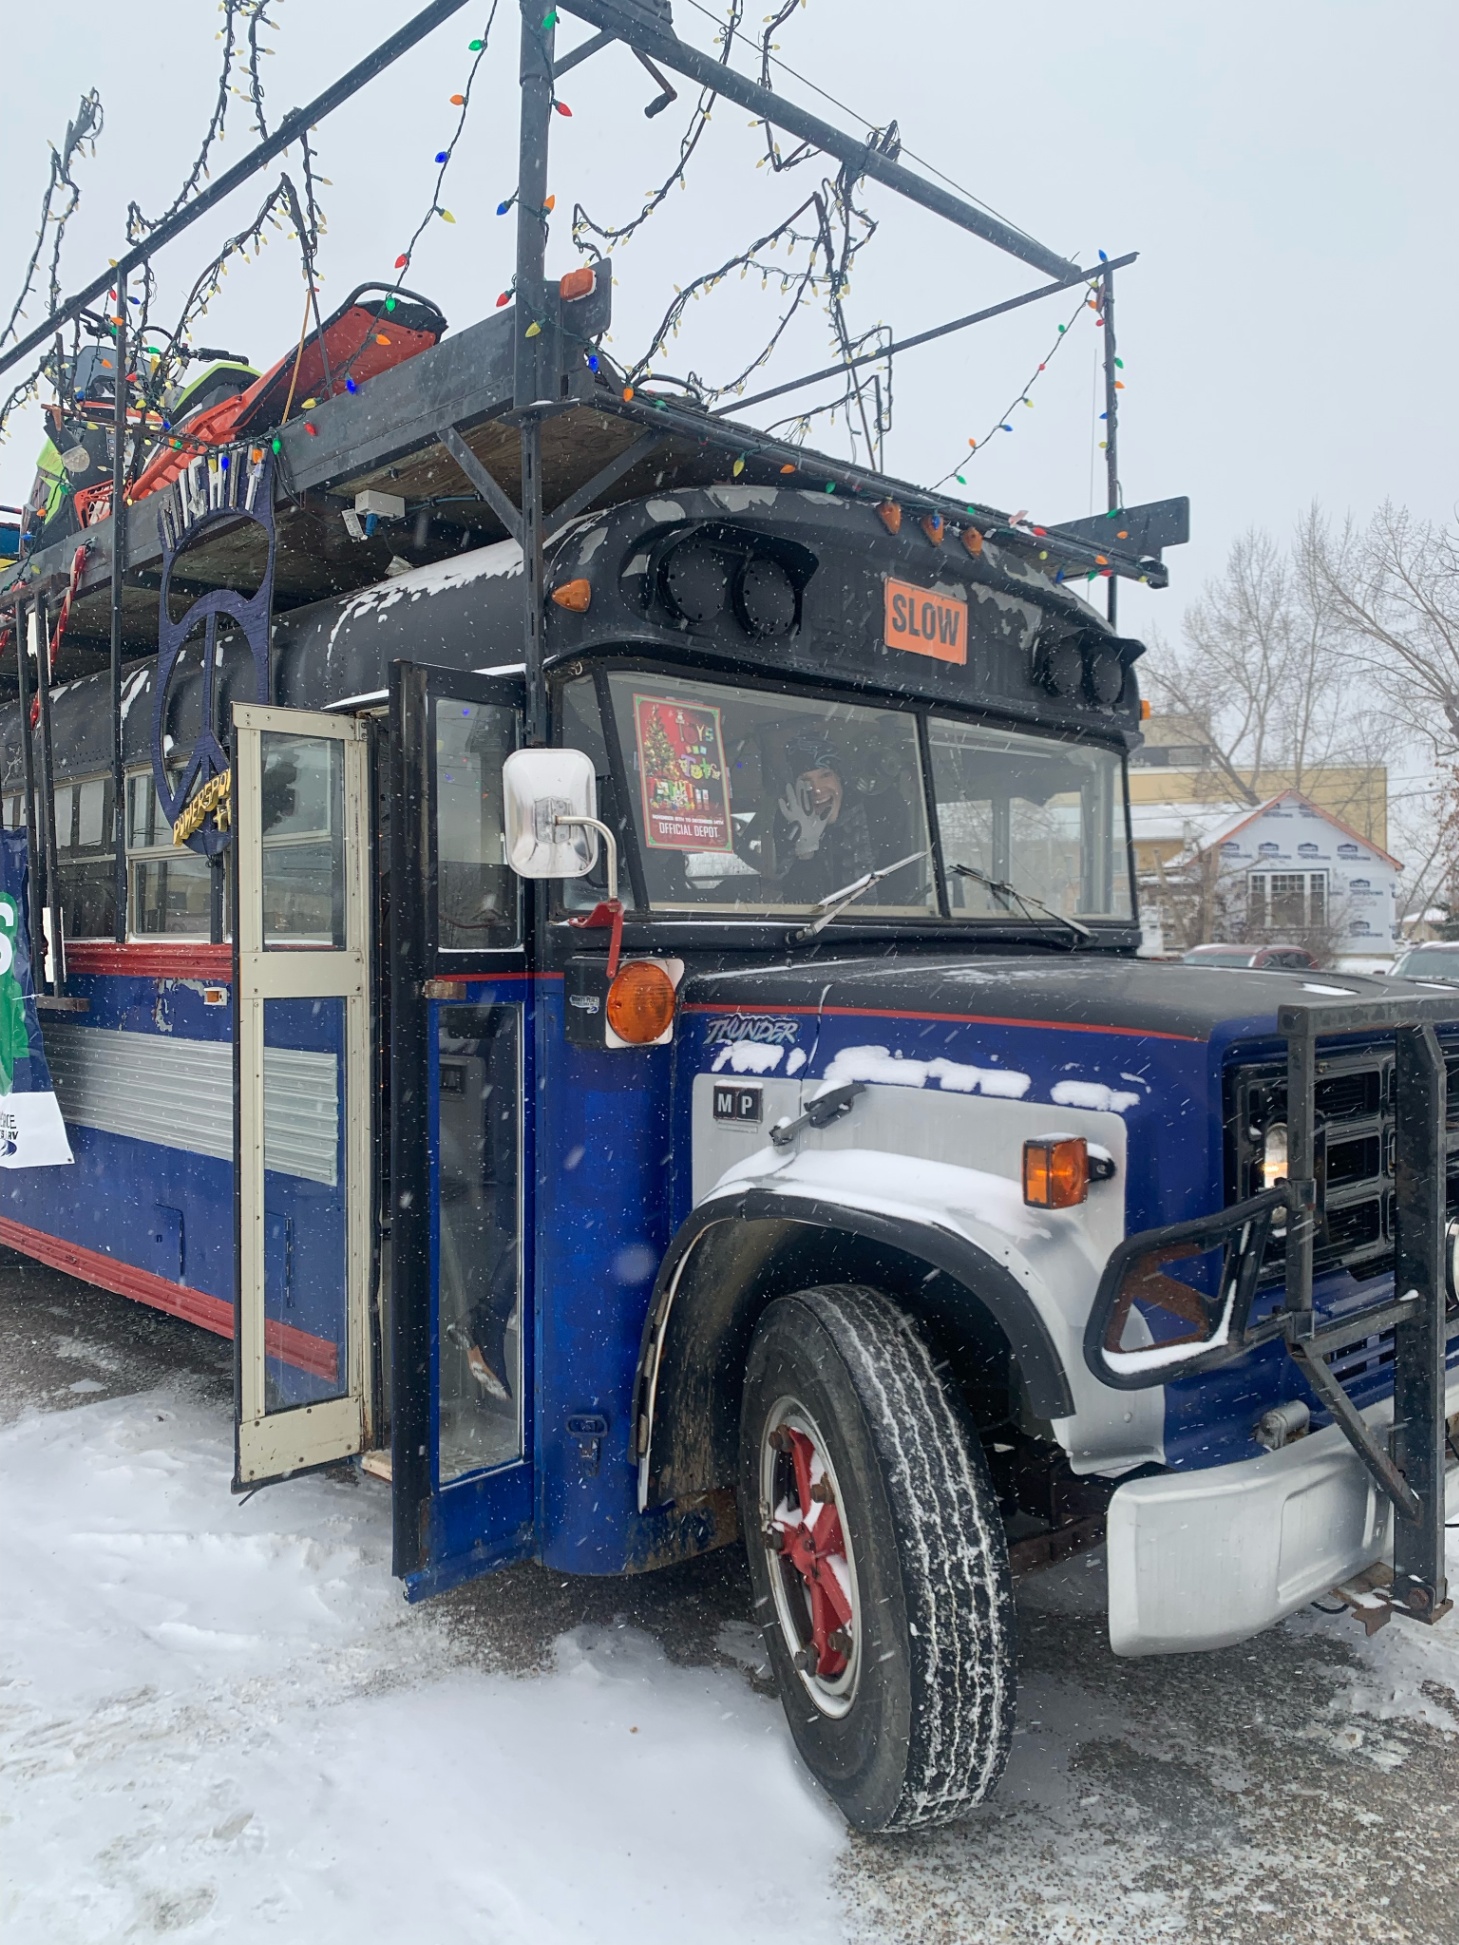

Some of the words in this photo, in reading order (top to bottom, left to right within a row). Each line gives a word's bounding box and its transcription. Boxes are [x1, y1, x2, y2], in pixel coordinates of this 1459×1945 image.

[892, 593, 960, 647] SLOW
[659, 822, 693, 836] OFFICIAL
[702, 1017, 798, 1045] THUNDER
